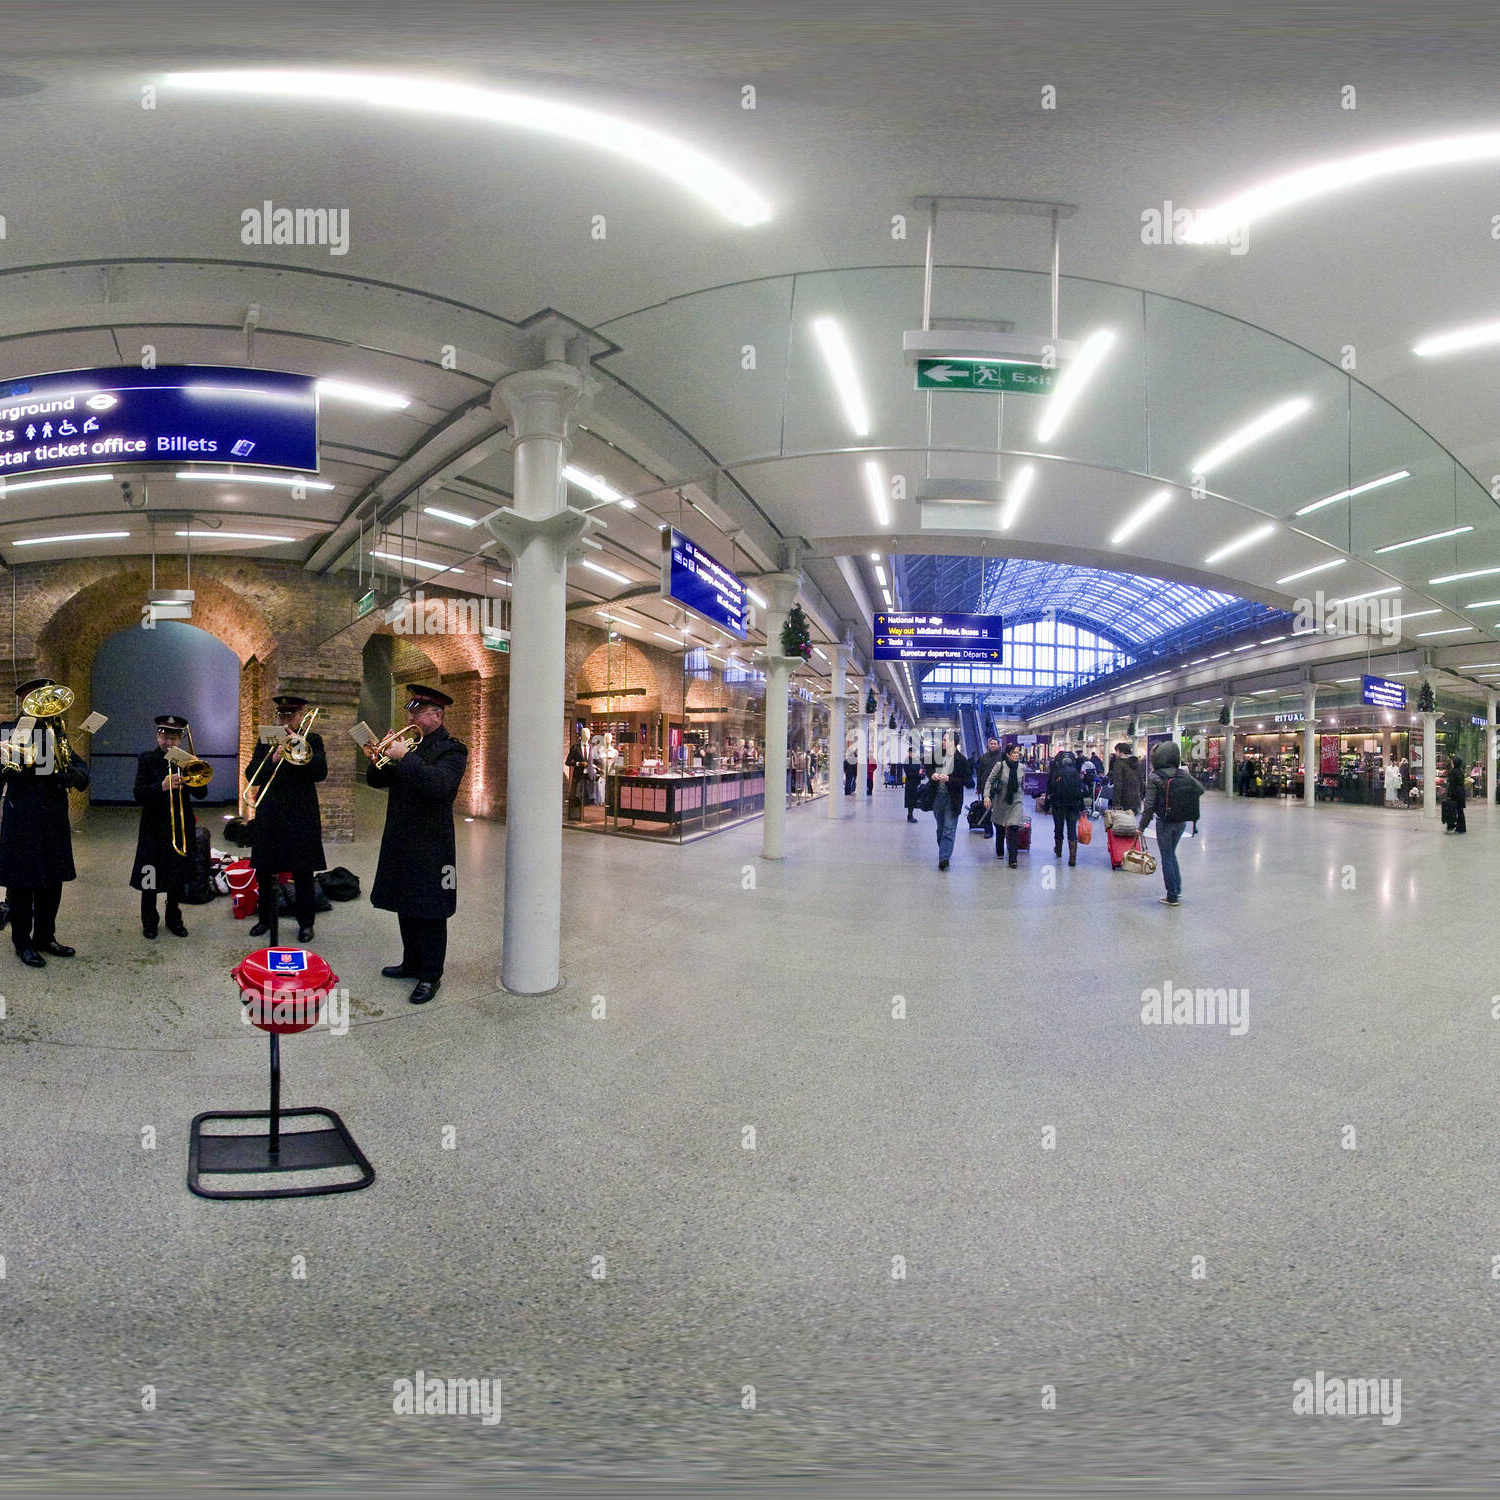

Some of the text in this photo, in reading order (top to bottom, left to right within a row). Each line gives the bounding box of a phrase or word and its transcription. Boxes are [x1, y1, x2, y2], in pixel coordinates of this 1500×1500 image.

[34, 442, 88, 465] ticket
[92, 437, 147, 455] office
[157, 436, 218, 453] Billets
[888, 627, 903, 636] Way
[917, 627, 942, 636] Midland
[961, 628, 979, 636] Buses
[927, 650, 961, 658] departures
[963, 650, 988, 659] Départs
